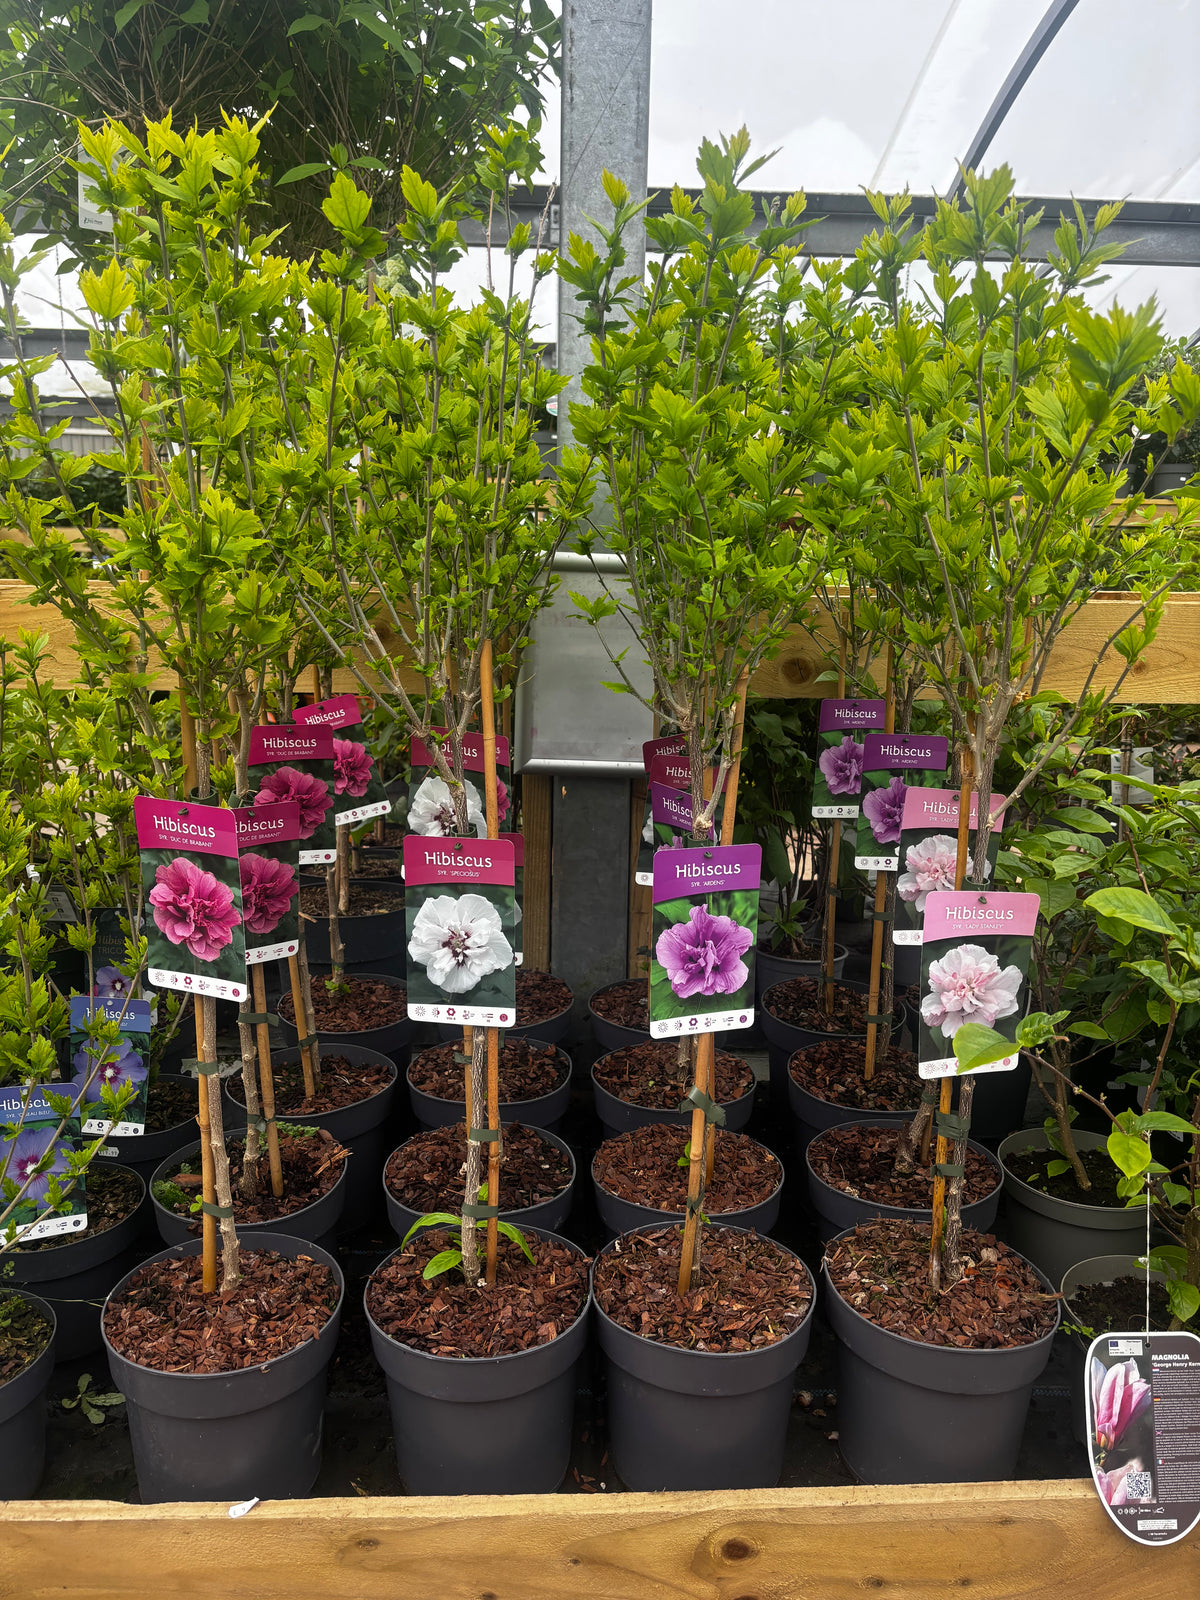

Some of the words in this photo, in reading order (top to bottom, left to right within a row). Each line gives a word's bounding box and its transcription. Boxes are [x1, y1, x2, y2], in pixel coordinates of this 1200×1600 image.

[305, 709, 346, 725] Hibiscus
[835, 708, 877, 719] Hibiscus
[263, 737, 317, 749] Hibiscus
[880, 745, 932, 757] Hibiscus
[153, 815, 216, 838] Hibiscus
[235, 819, 285, 834] ibiscus
[424, 851, 493, 868] Hibiscus
[675, 862, 741, 879] Hibiscus
[945, 906, 1014, 920] Hibiscus
[0, 1098, 52, 1111] Hibiscu
[1151, 1353, 1190, 1361] MAGNOLIA
